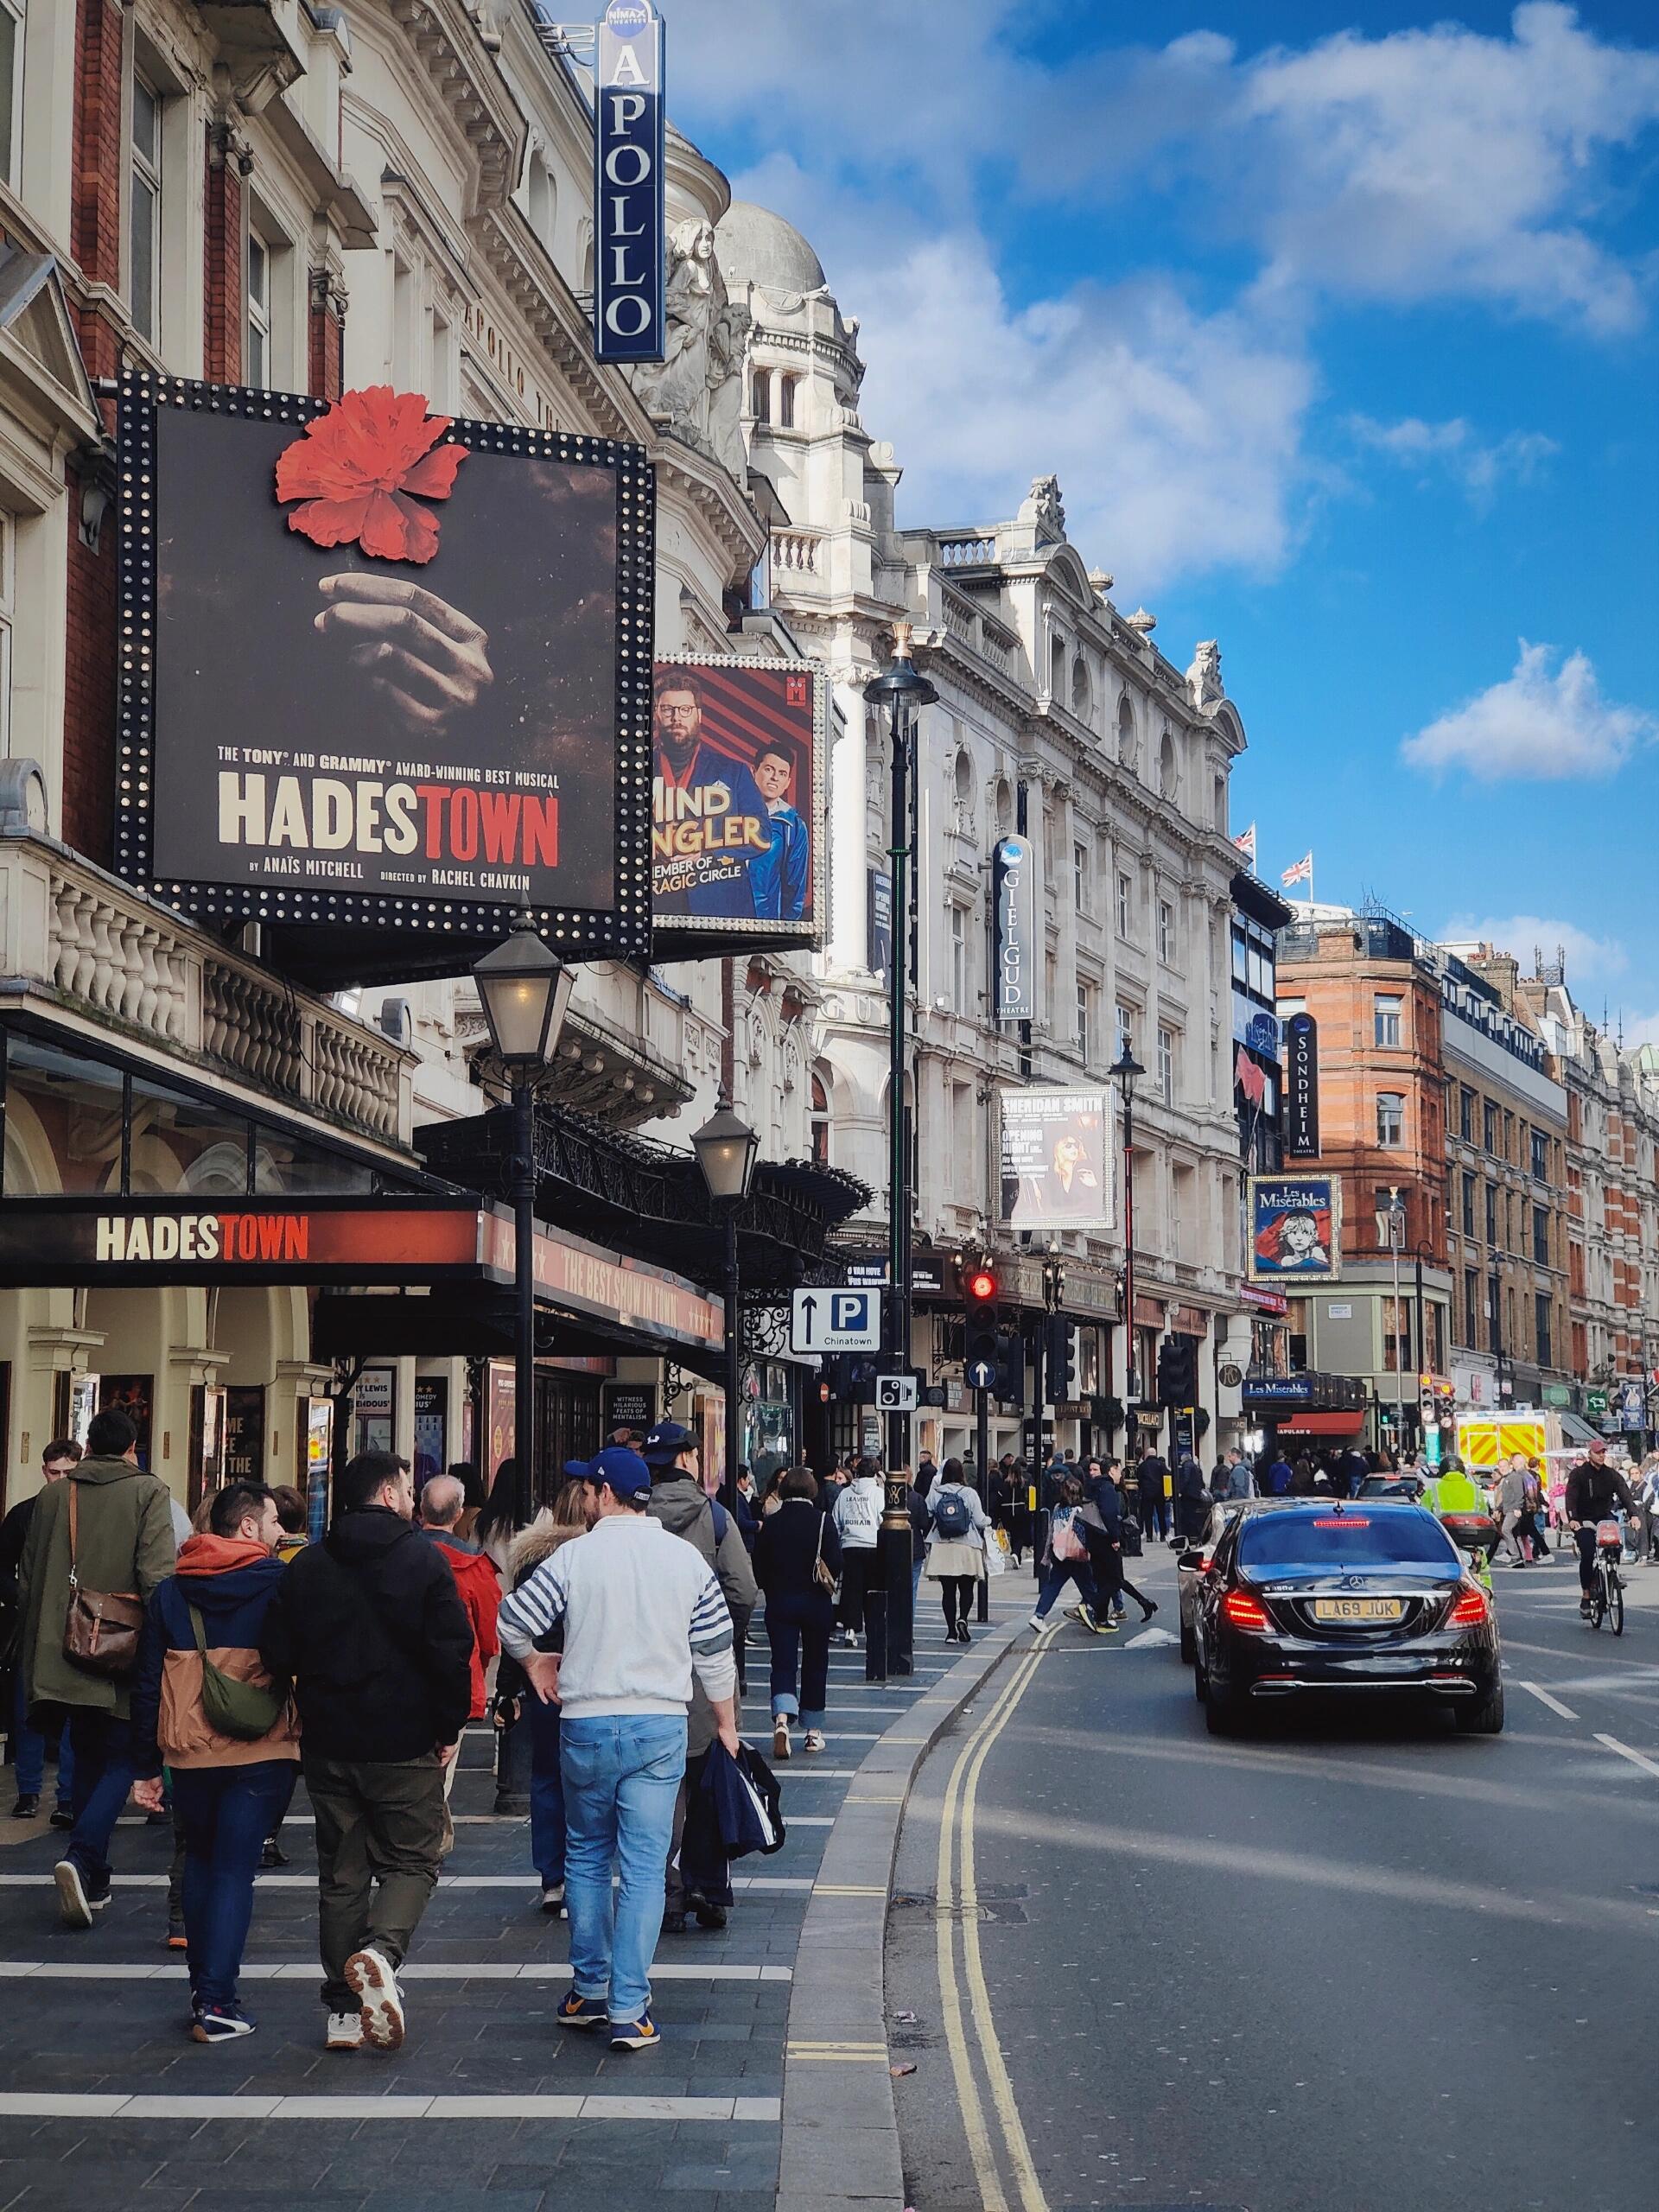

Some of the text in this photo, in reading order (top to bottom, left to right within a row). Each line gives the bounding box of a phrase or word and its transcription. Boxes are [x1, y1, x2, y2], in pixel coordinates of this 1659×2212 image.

[606, 44, 652, 337] APOLLO
[464, 305, 524, 399] APOLLO
[218, 745, 239, 762] THE
[293, 753, 315, 768] AND
[395, 761, 481, 783] AWARD-WINNING
[485, 769, 512, 785] BEST
[515, 772, 560, 789] MUSICAL
[218, 771, 559, 868] HADESTOWN
[249, 855, 530, 891] BY ANAÏS MITCHELL DIRECTED BY RACHEL CHAVKIN
[696, 855, 713, 869] OF
[699, 865, 741, 884] CIRCLE
[1003, 869, 1021, 1004] GIELGUD
[1063, 1096, 1103, 1113] SMITH
[1297, 1036, 1310, 1147] SONDHEIM
[1260, 1192, 1326, 1209] Misérables
[1283, 1186, 1300, 1198] Les
[96, 1214, 308, 1262] HADESTOWN
[586, 1257, 613, 1307] BEST
[613, 1269, 643, 1319] SHOW
[643, 1279, 654, 1321] IN
[838, 1297, 861, 1328] P
[823, 1337, 872, 1345] Chinatown
[1249, 1383, 1308, 1394] Les Misérables
[228, 1457, 252, 1473] THE
[1322, 1601, 1395, 1616] LA69 JUK
